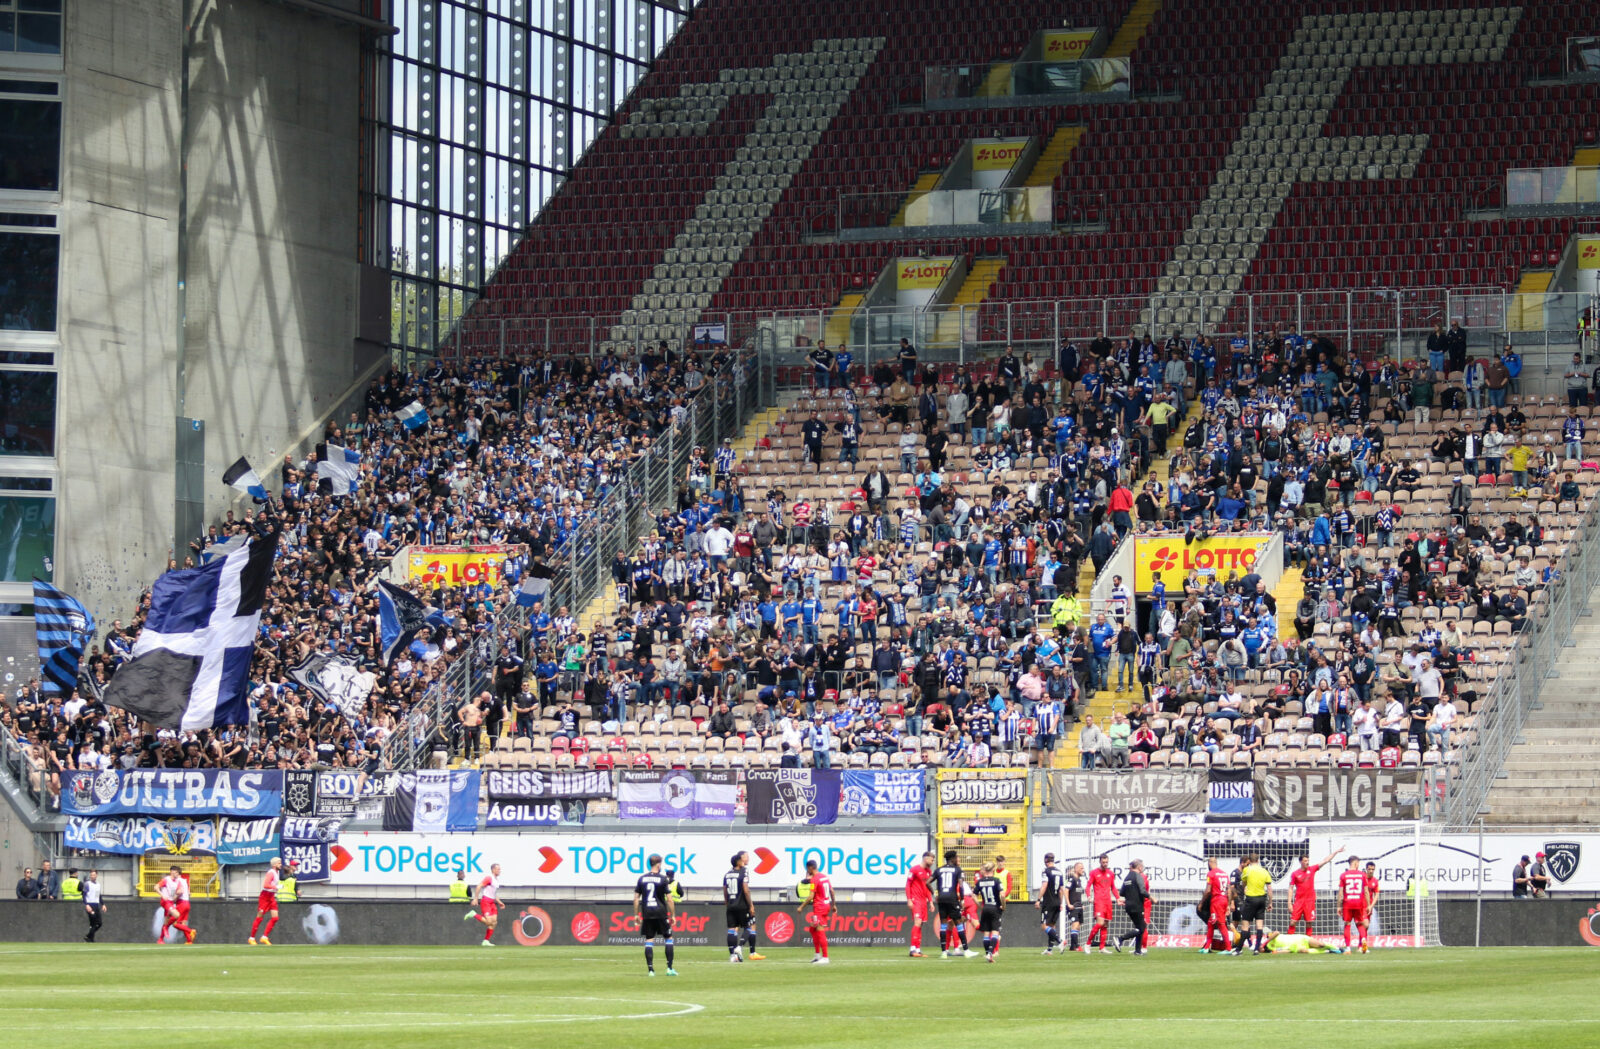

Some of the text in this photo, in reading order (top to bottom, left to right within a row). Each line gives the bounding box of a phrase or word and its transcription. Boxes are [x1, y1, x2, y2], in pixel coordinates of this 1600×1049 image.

[1063, 39, 1091, 50] LOTT
[1183, 548, 1257, 569] LOTTO
[452, 562, 501, 582] LOTT
[489, 771, 611, 794] GEISS-NIDDA
[625, 771, 728, 781] Arminia Fans
[747, 769, 808, 784] Crazy Blue
[874, 772, 921, 786] BLOCK
[1061, 773, 1200, 795] FETTKATZEN
[120, 771, 263, 810] ULTRAS
[874, 785, 921, 803] ZWO
[940, 780, 1024, 802] SAMSON
[1212, 781, 1249, 799] DHSG
[1263, 774, 1394, 817] SPENGE
[627, 806, 727, 816] Rhein- Main
[1102, 796, 1158, 810] ON TOUR
[974, 826, 1005, 834] ARMINIA
[233, 847, 261, 857] ULTRAS
[284, 845, 321, 859] 3.MAI
[357, 845, 484, 873] TOPdesk
[726, 878, 738, 895] 30
[941, 872, 953, 888] 10
[1345, 879, 1363, 894] 23
[646, 883, 656, 901] 2
[982, 886, 996, 905] 14
